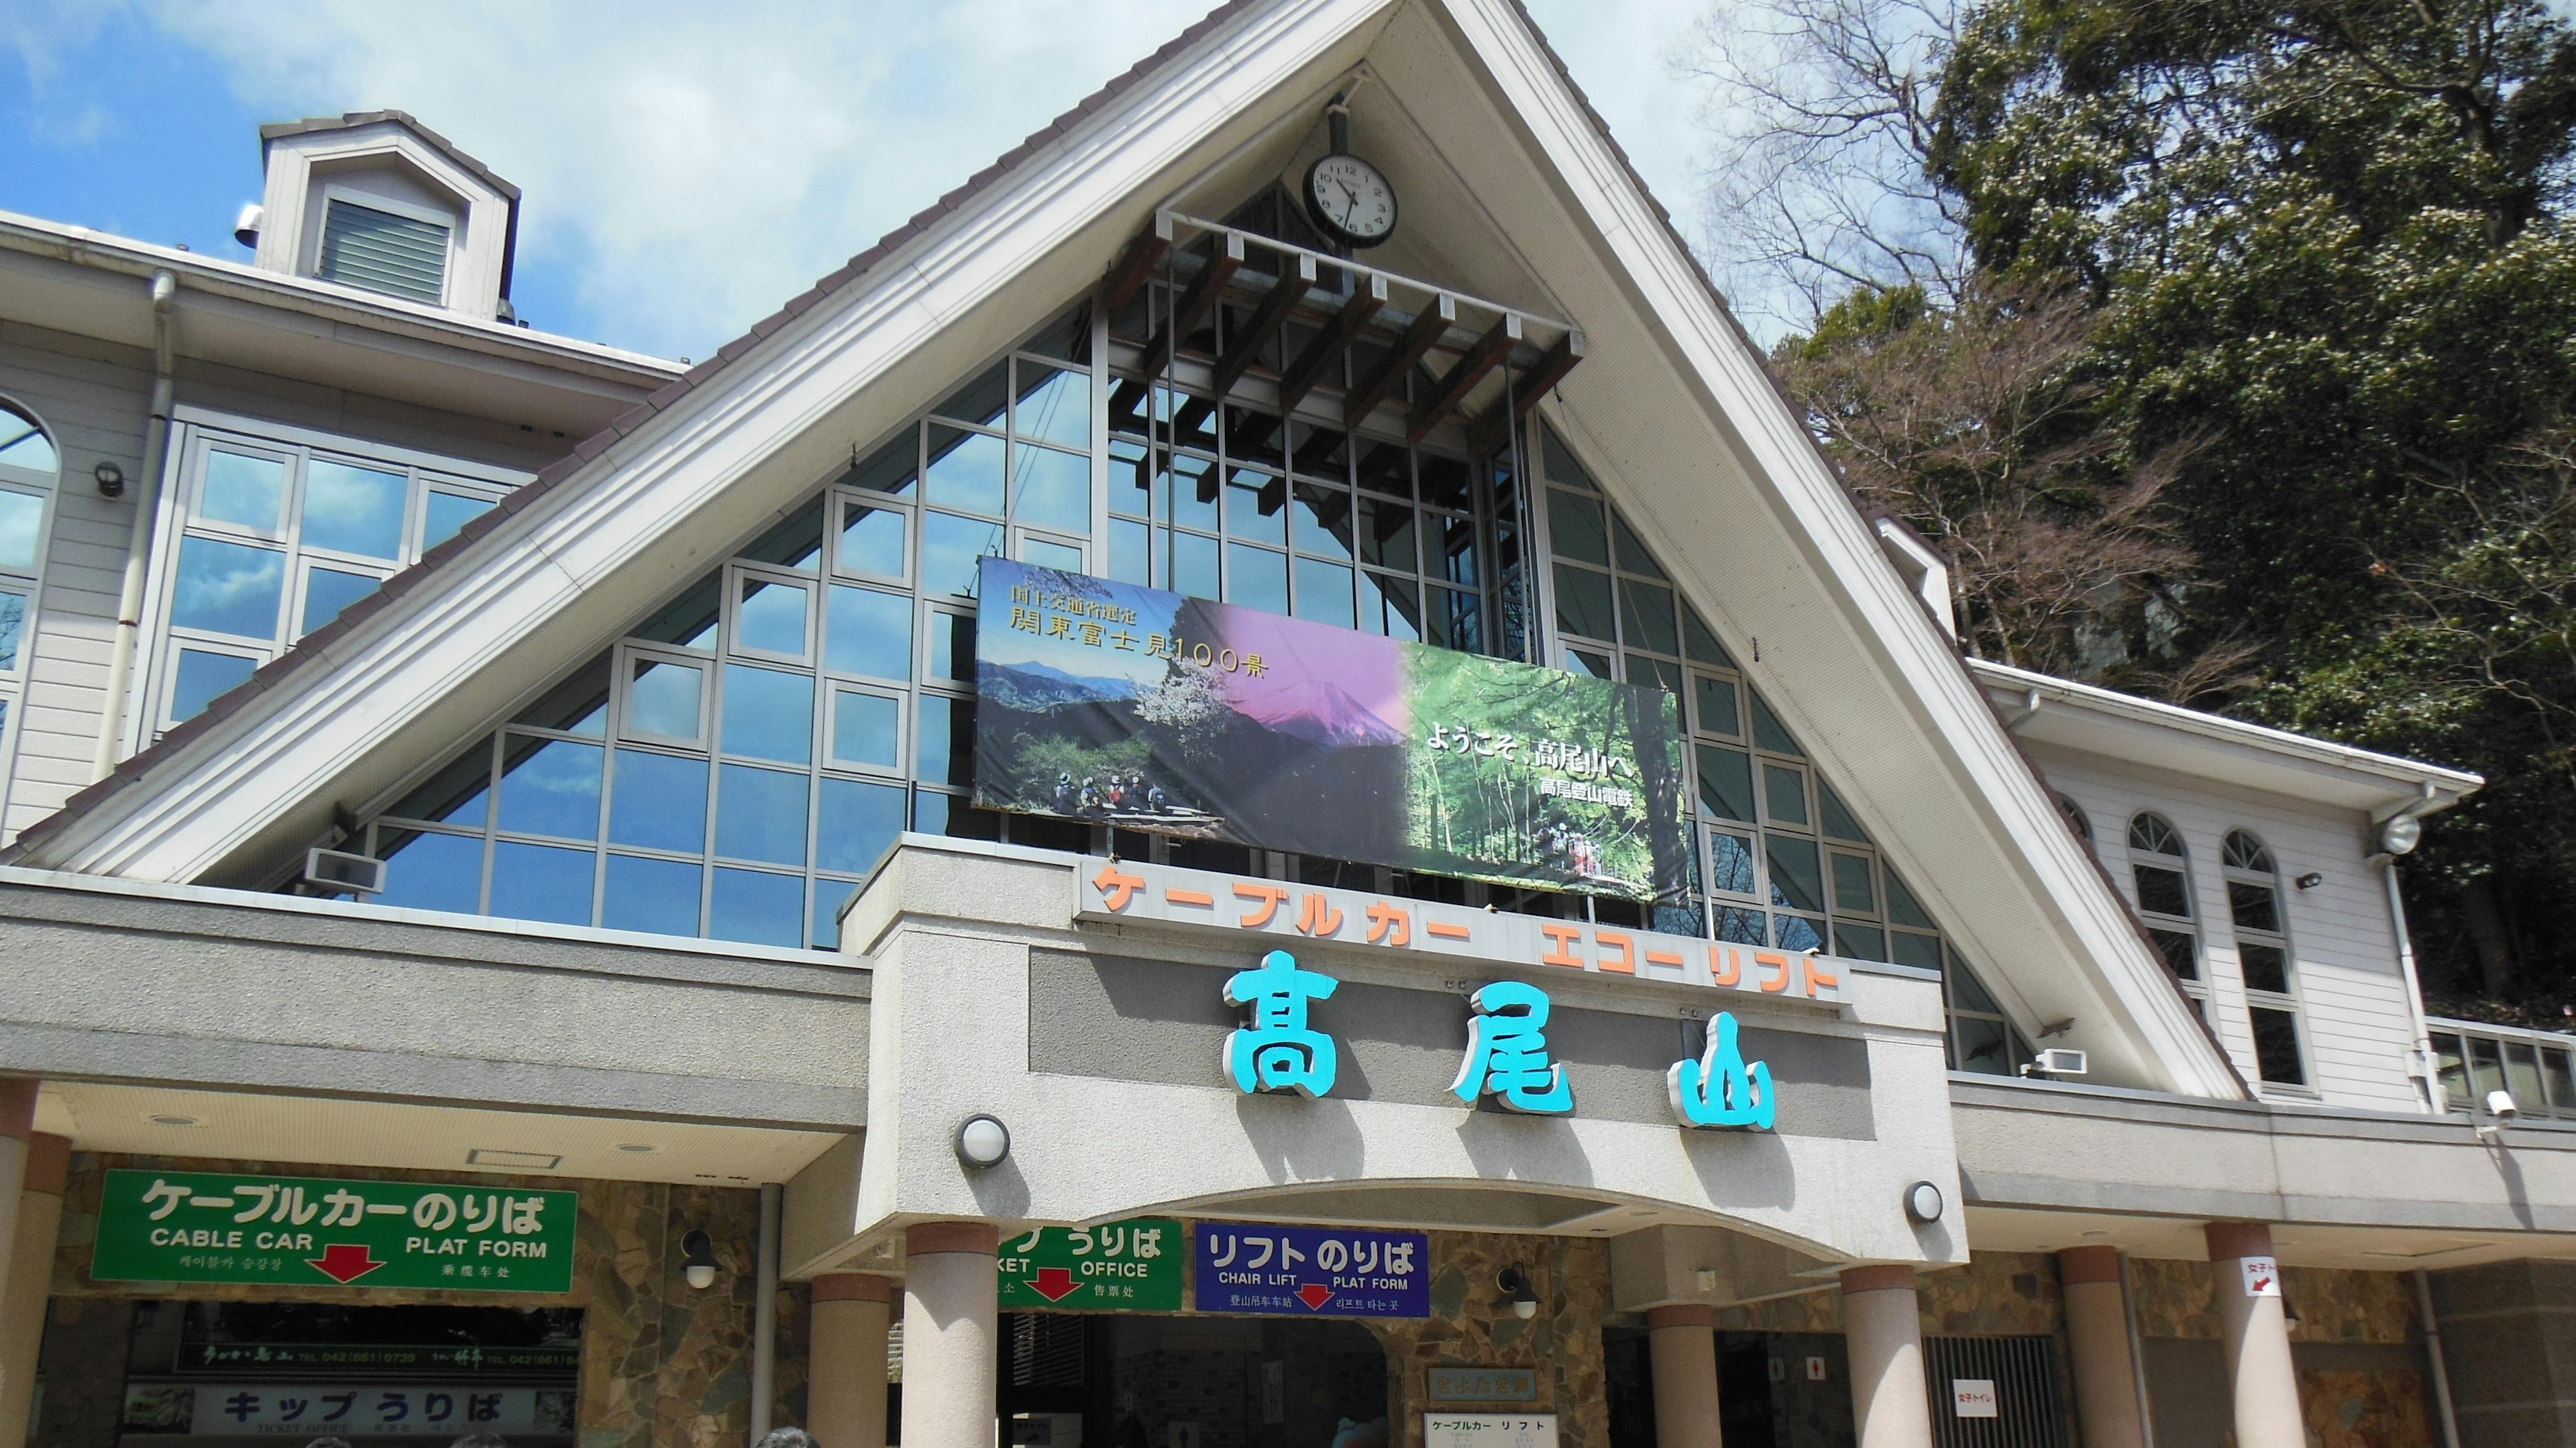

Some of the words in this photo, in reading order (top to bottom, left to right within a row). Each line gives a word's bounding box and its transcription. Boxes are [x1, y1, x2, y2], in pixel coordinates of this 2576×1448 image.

[1330, 165, 1340, 174] 11
[1346, 166, 1356, 175] 12
[1320, 172, 1332, 183] 10
[1316, 185, 1326, 193] 9
[1374, 188, 1382, 197] 2
[1322, 200, 1330, 209] 8
[1377, 203, 1386, 213] 3
[1335, 214, 1343, 222] 7
[1375, 217, 1383, 225] 4
[1349, 223, 1358, 232] 6
[1365, 223, 1373, 233] 5
[1011, 584, 1136, 625] 国土交通省選定
[1541, 778, 1633, 809] 高尾登山電鉄
[1092, 866, 1470, 946] ケーブルカー
[142, 1179, 545, 1234] ケーブルカーのりば
[150, 1229, 243, 1248] CABLE
[256, 1232, 313, 1250] CAR
[406, 1237, 468, 1255] PLAT
[478, 1240, 547, 1258] FORM
[1081, 1261, 1148, 1278] OFFICE
[1219, 1272, 1260, 1285] CHAIR
[1269, 1274, 1297, 1286] LIFT
[1333, 1276, 1366, 1288] PLAT
[1372, 1278, 1408, 1290] FORM
[1433, 1421, 1491, 1430] ケーブルカー
